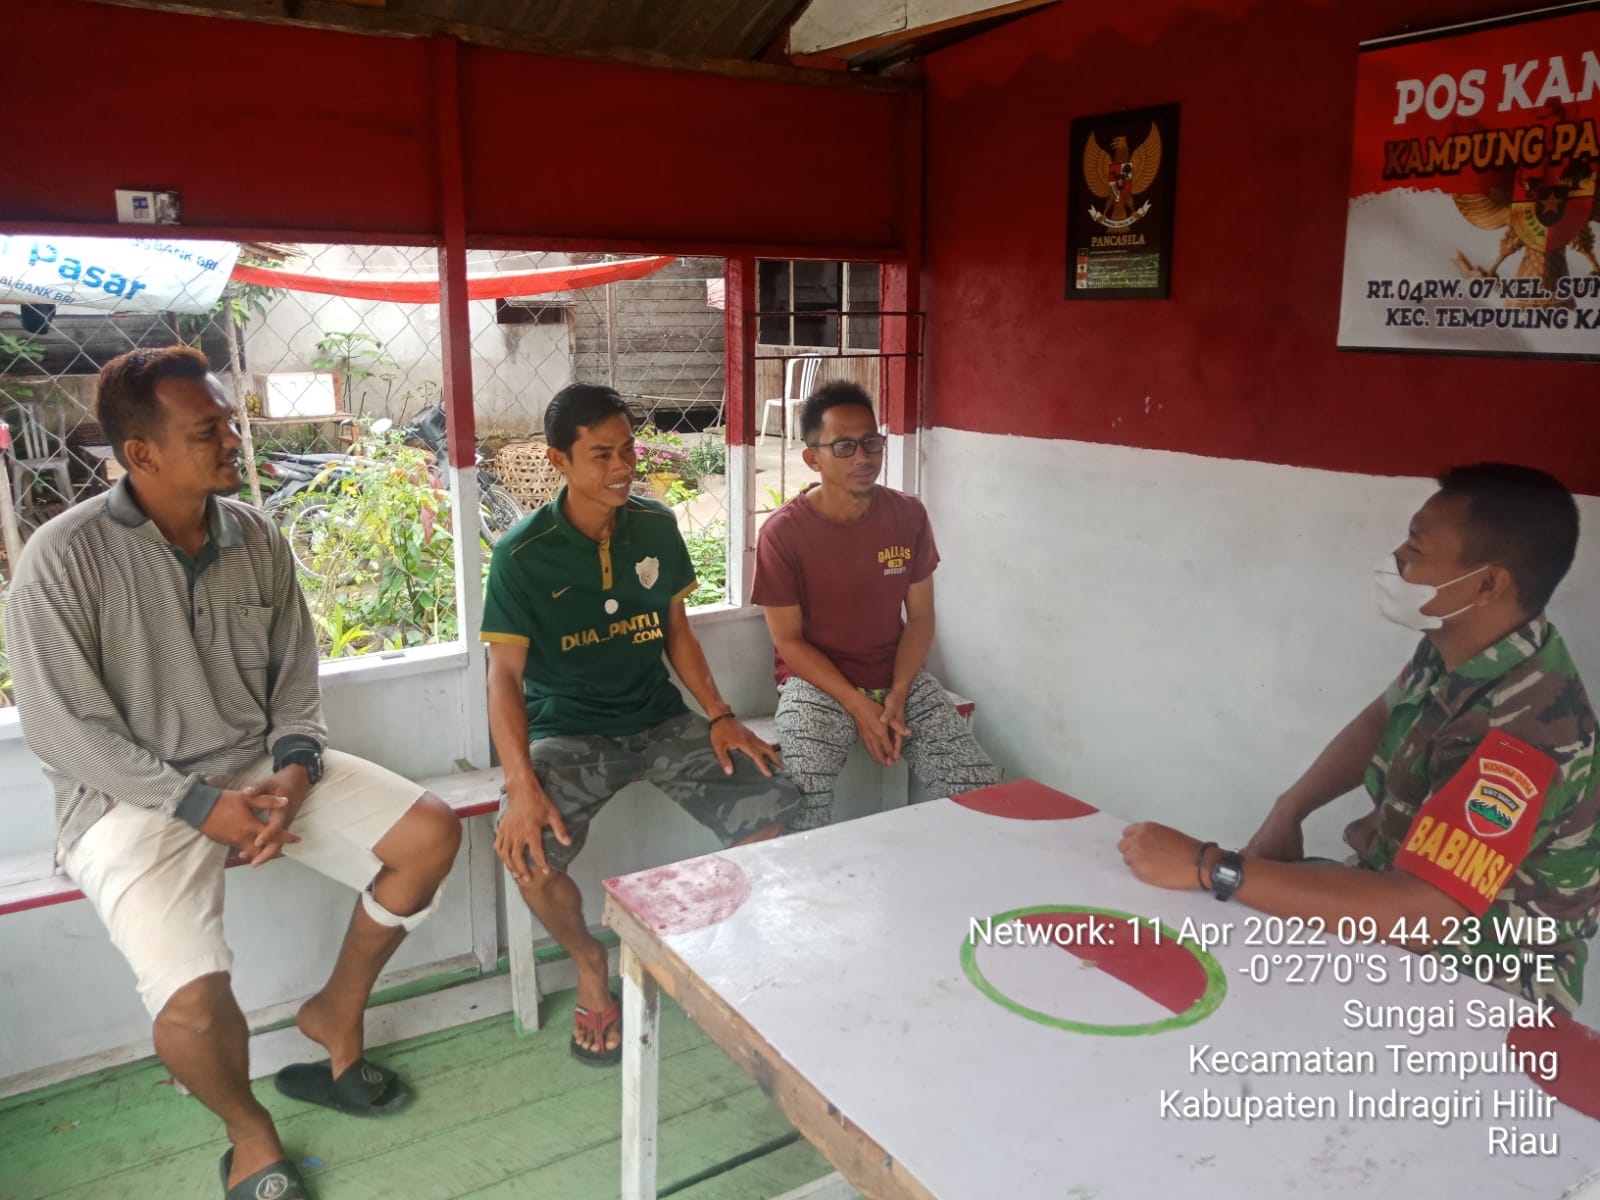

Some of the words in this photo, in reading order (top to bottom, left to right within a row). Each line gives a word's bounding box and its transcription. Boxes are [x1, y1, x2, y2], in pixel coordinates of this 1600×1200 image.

[1393, 69, 1487, 125] POS
[1384, 127, 1545, 177] KAMPUNG
[1551, 120, 1600, 162] PA
[1091, 233, 1145, 247] PANCASILA
[196, 255, 219, 271] BRI
[15, 279, 53, 299] BANK
[54, 291, 76, 304] BRI
[1469, 279, 1497, 299] 07
[1500, 278, 1552, 299] KEL.
[1385, 308, 1430, 327] KEC.
[1436, 308, 1569, 329] TEMPULING
[877, 546, 911, 564] DALLAS
[631, 628, 664, 644] .COM
[1406, 815, 1513, 904] BABINSA
